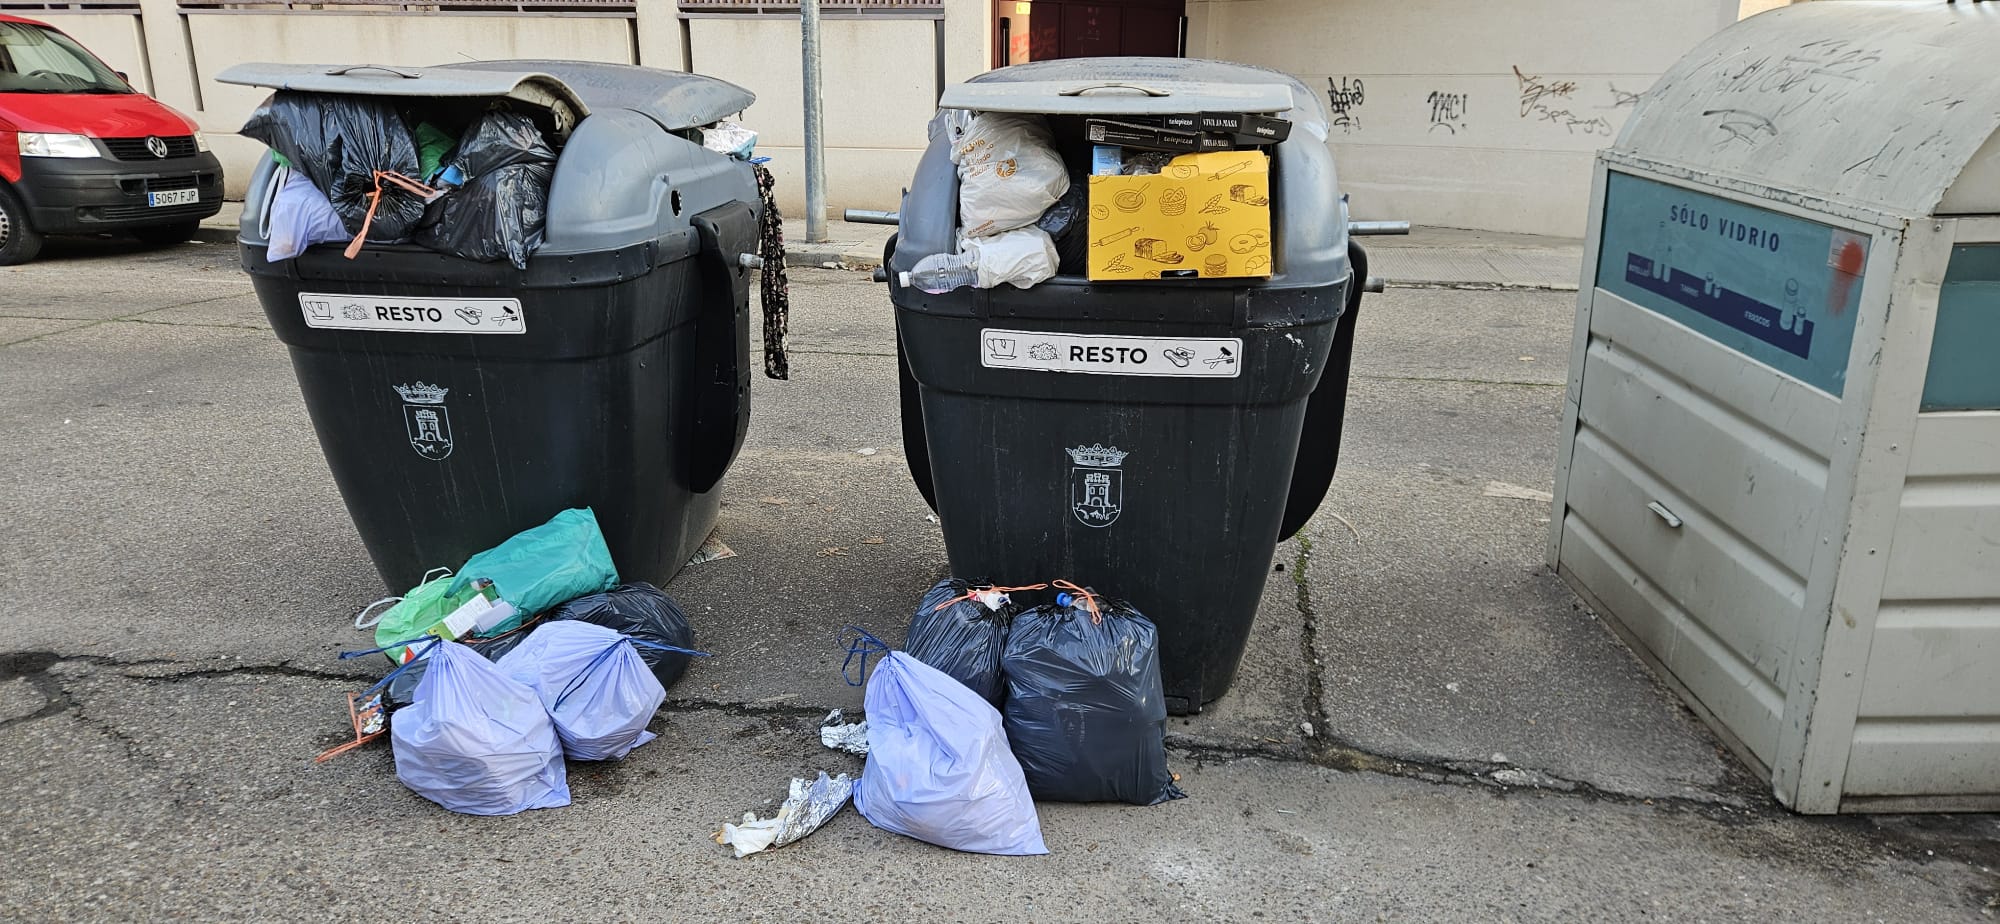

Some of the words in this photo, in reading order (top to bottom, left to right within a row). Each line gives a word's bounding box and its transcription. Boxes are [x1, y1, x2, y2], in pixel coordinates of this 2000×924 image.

[155, 191, 178, 205] 5067
[180, 190, 196, 203] FJP
[1670, 203, 1709, 231] SÓLO
[1719, 217, 1781, 253] VIDRIO
[374, 305, 443, 323] RESTO
[1069, 345, 1148, 364] RESTO
